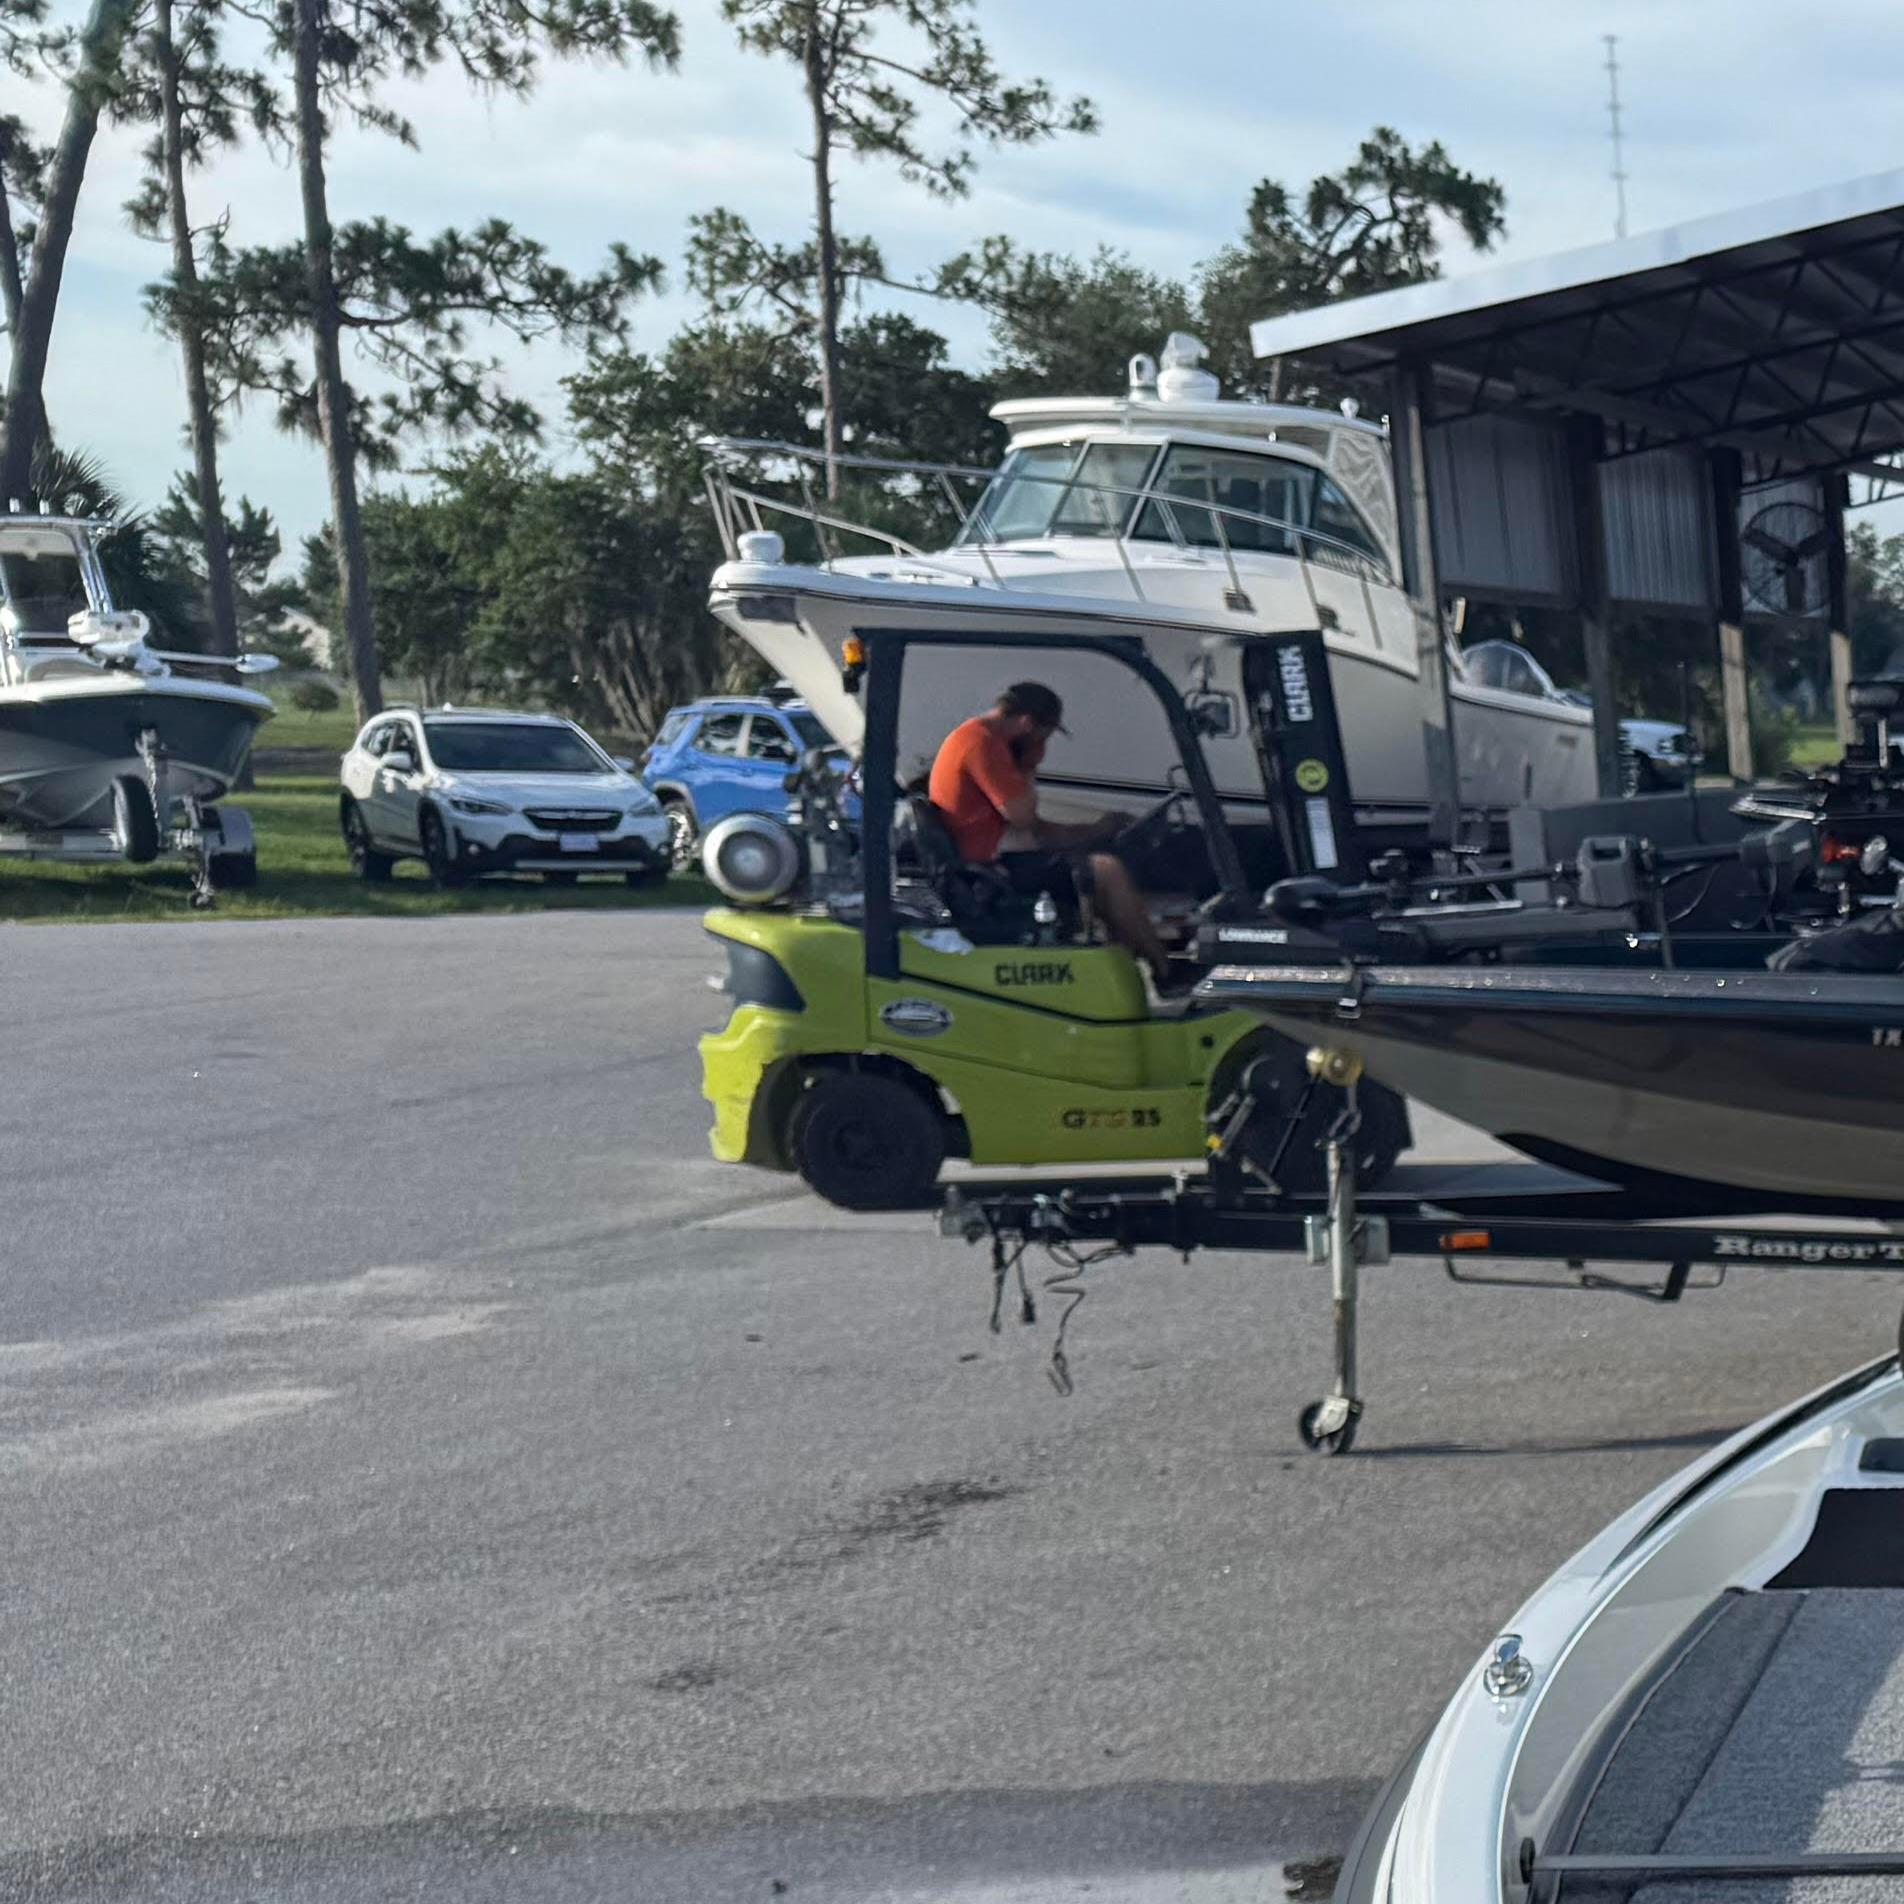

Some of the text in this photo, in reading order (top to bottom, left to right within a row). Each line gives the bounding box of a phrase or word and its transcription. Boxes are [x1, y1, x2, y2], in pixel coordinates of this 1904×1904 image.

[1277, 645, 1313, 721] CLARK
[994, 962, 1074, 985] CLARK
[1872, 1028, 1901, 1047] TX
[1713, 1235, 1876, 1261] Ranger
